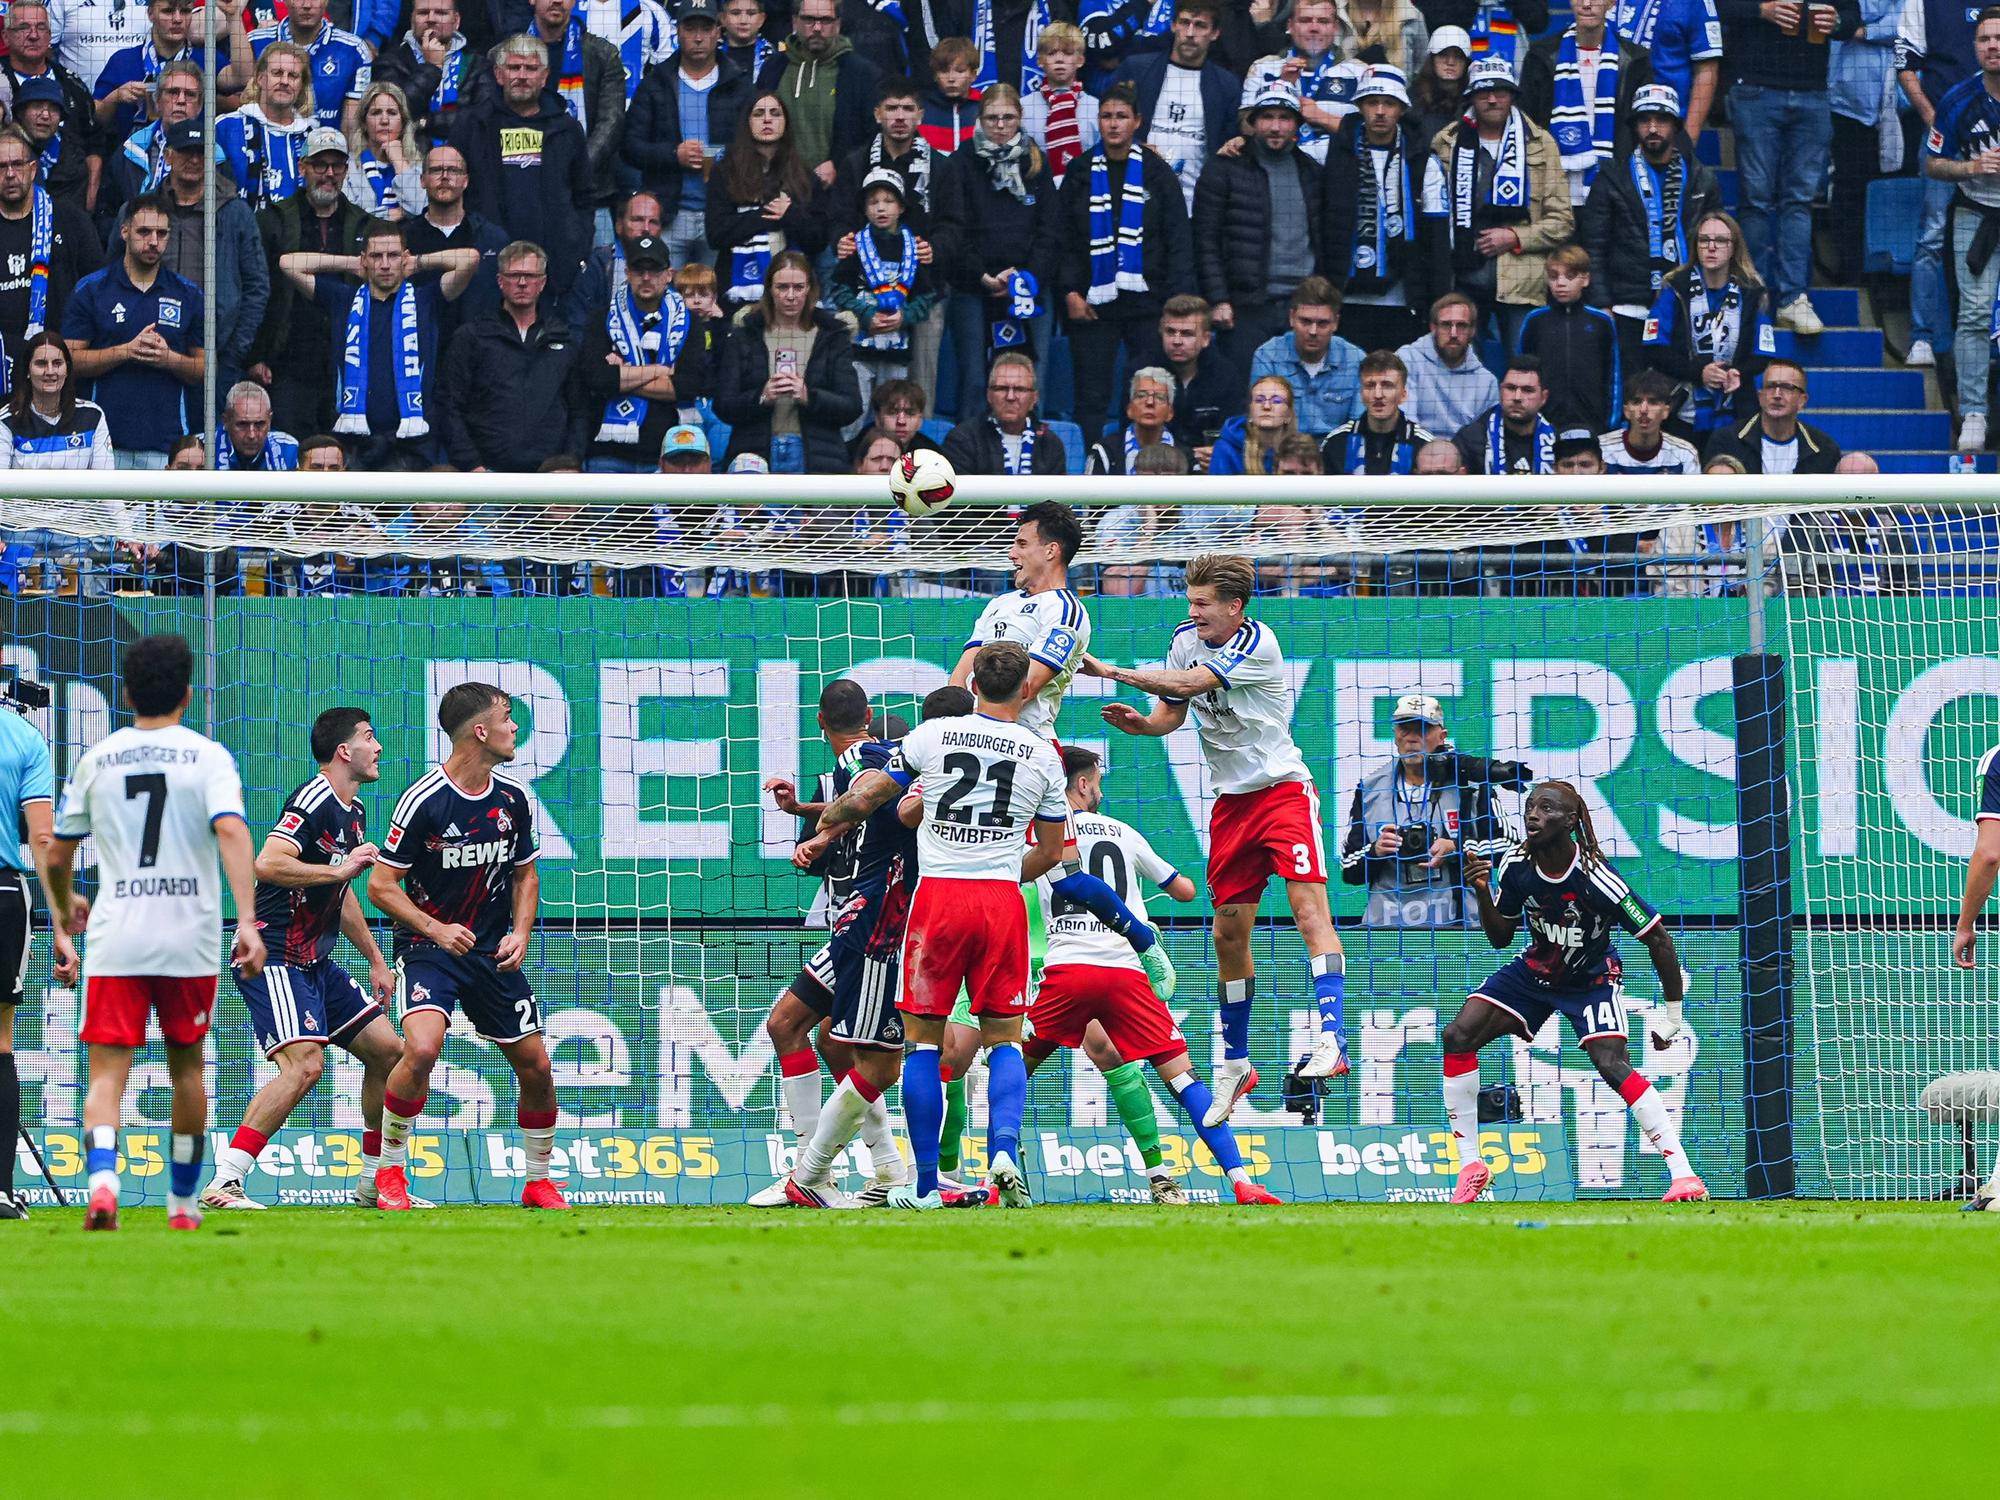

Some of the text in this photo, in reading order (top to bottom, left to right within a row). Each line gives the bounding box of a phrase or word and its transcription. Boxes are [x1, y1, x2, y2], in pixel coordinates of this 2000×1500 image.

[1455, 146, 1475, 229] HANSESTADT
[96, 746, 178, 769] HAMBURGER
[942, 731, 1034, 760] HAMBURGER SV
[935, 752, 1017, 828] 21
[125, 773, 167, 868] 7
[1076, 822, 1123, 838] RGER SV
[442, 839, 510, 869] REWE
[1292, 843, 1312, 875] 3
[1623, 898, 1646, 924] DEVK
[1583, 1001, 1616, 1034] 14
[486, 1133, 720, 1179] bet365
[1316, 1131, 1547, 1175] bet365
[279, 1189, 356, 1204] SPORTWE
[1109, 1188, 1220, 1204] SPORTTEN
